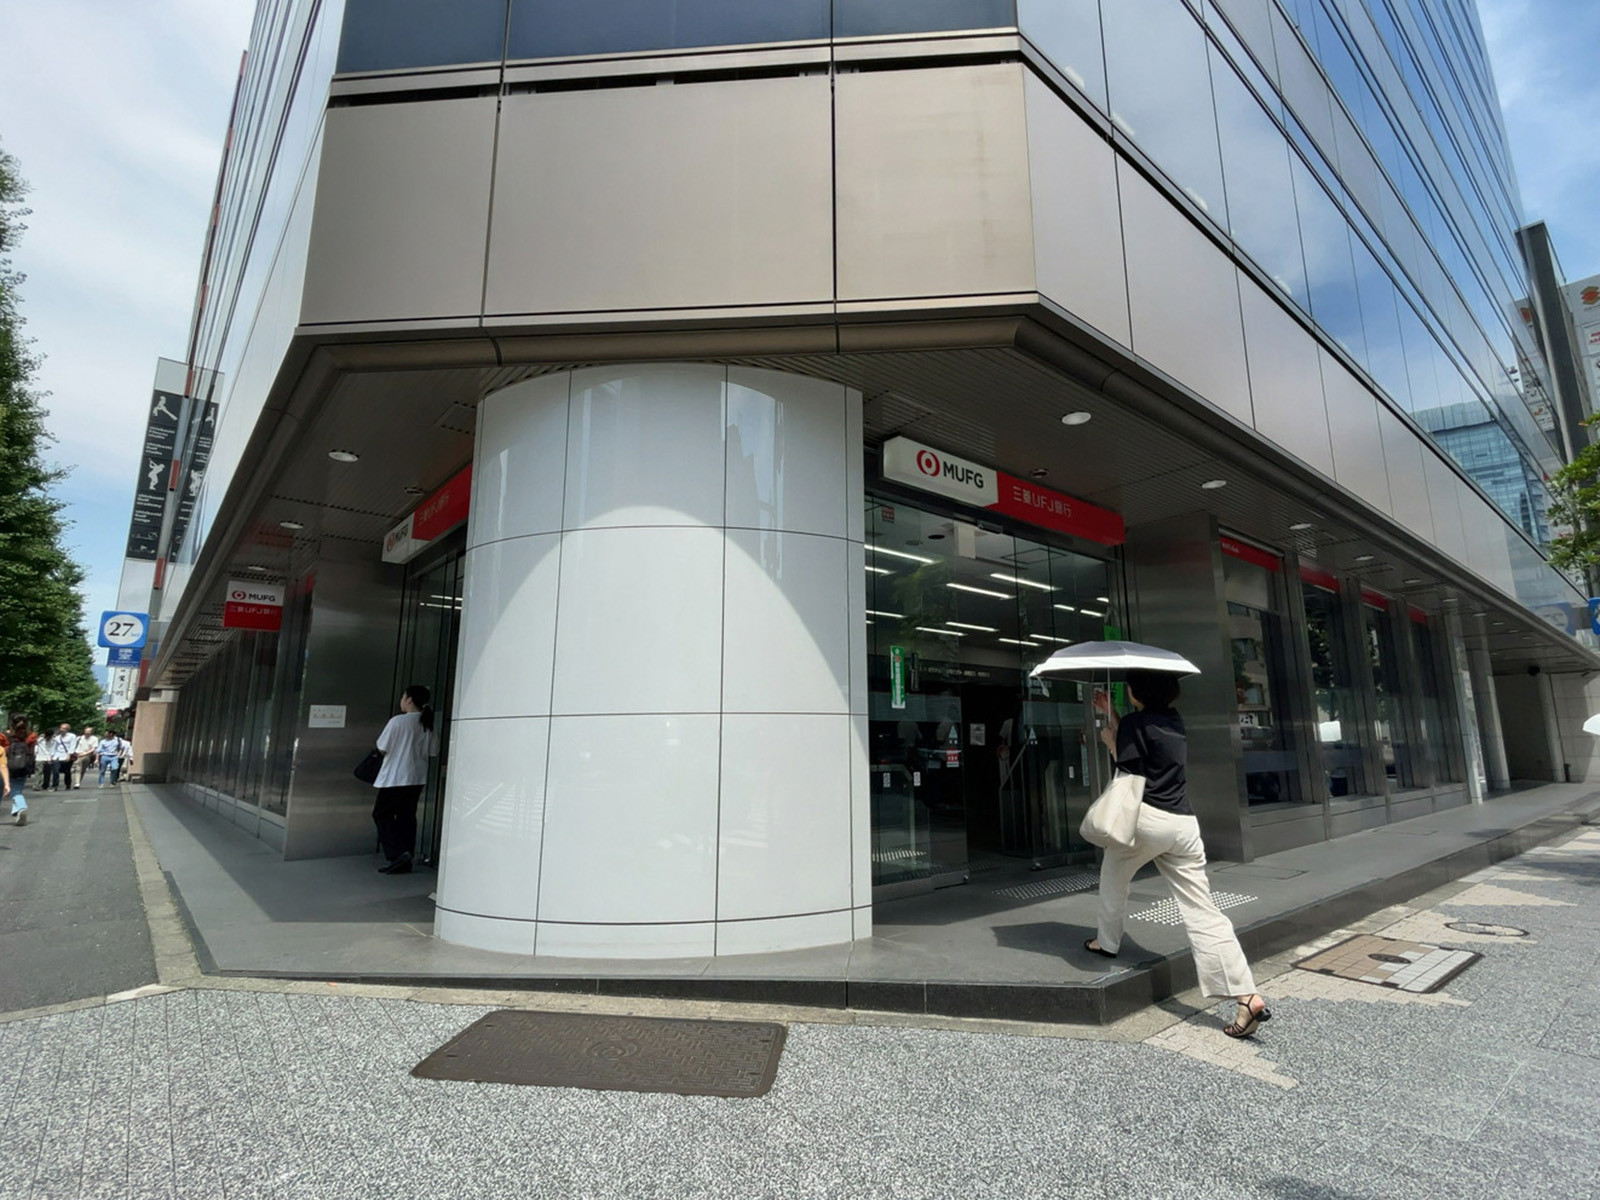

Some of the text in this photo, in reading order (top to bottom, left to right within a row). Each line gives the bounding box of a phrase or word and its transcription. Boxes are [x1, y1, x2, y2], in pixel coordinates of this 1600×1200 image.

[943, 460, 984, 489] MUFG
[1012, 485, 1073, 519] 三菱UFJ銀行
[248, 592, 276, 602] MUFG
[108, 621, 135, 637] 27
